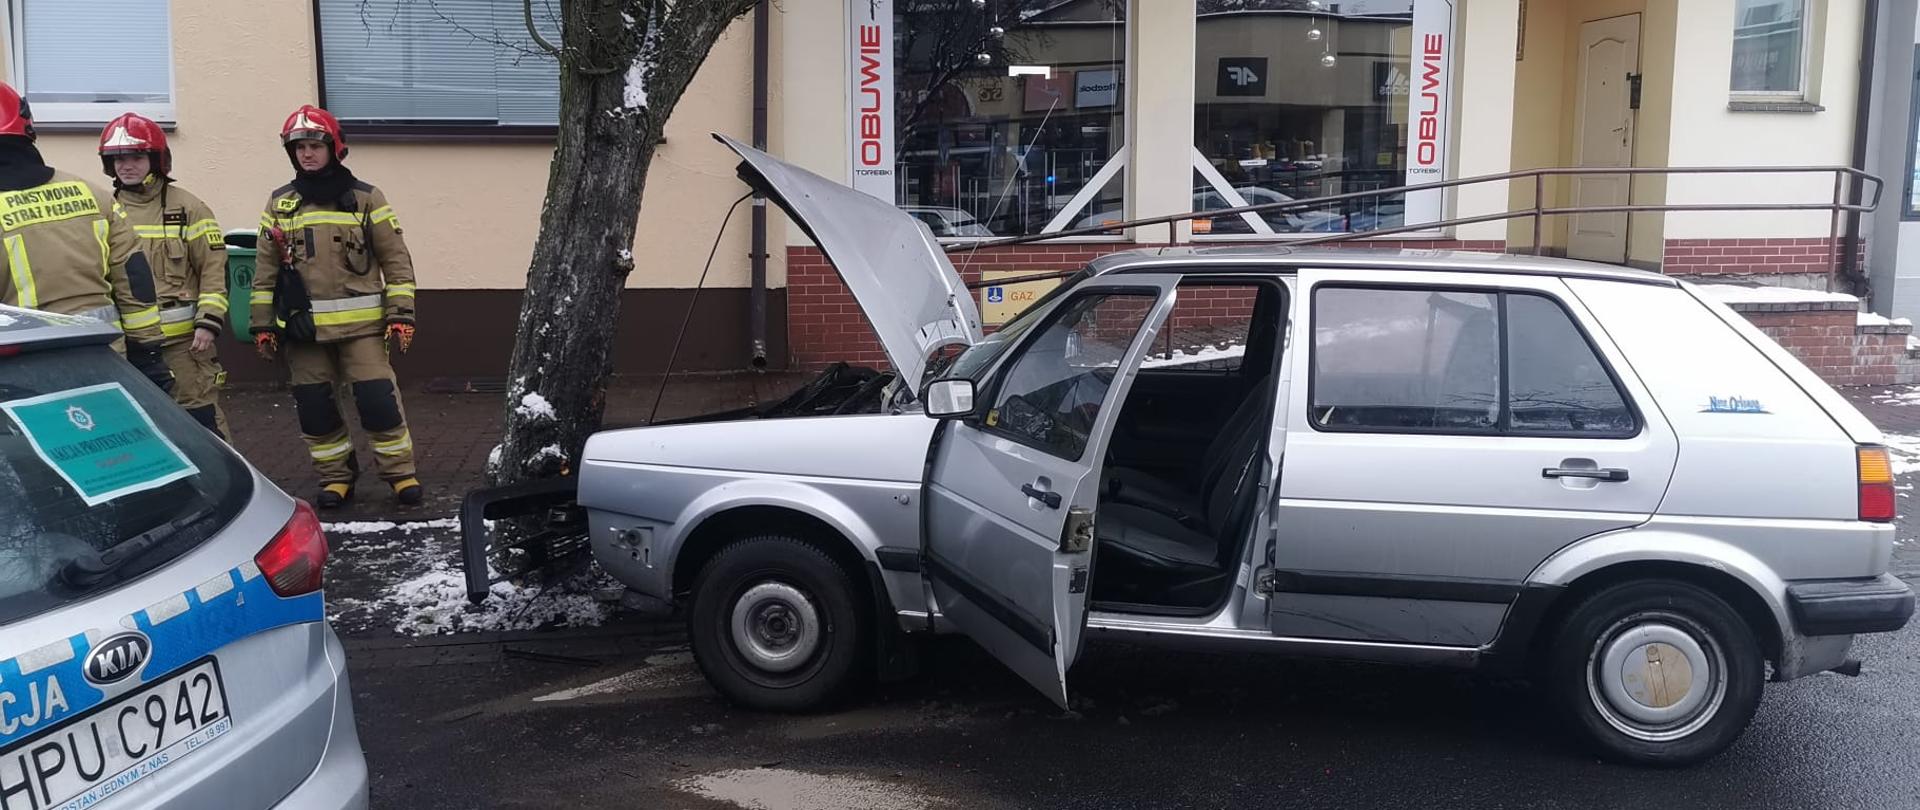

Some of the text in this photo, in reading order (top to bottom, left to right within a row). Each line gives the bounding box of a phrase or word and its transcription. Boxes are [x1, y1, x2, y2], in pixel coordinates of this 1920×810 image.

[860, 25, 881, 166] OBUWIE
[1417, 34, 1443, 165] OBUWIE
[1010, 291, 1034, 301] GAZ
[97, 640, 143, 678] KIA
[118, 672, 219, 759] C942
[184, 718, 230, 751] TEL. 19 997
[99, 770, 139, 798] JEDNYM
[140, 764, 148, 775] Z
[148, 753, 169, 771] NAS
